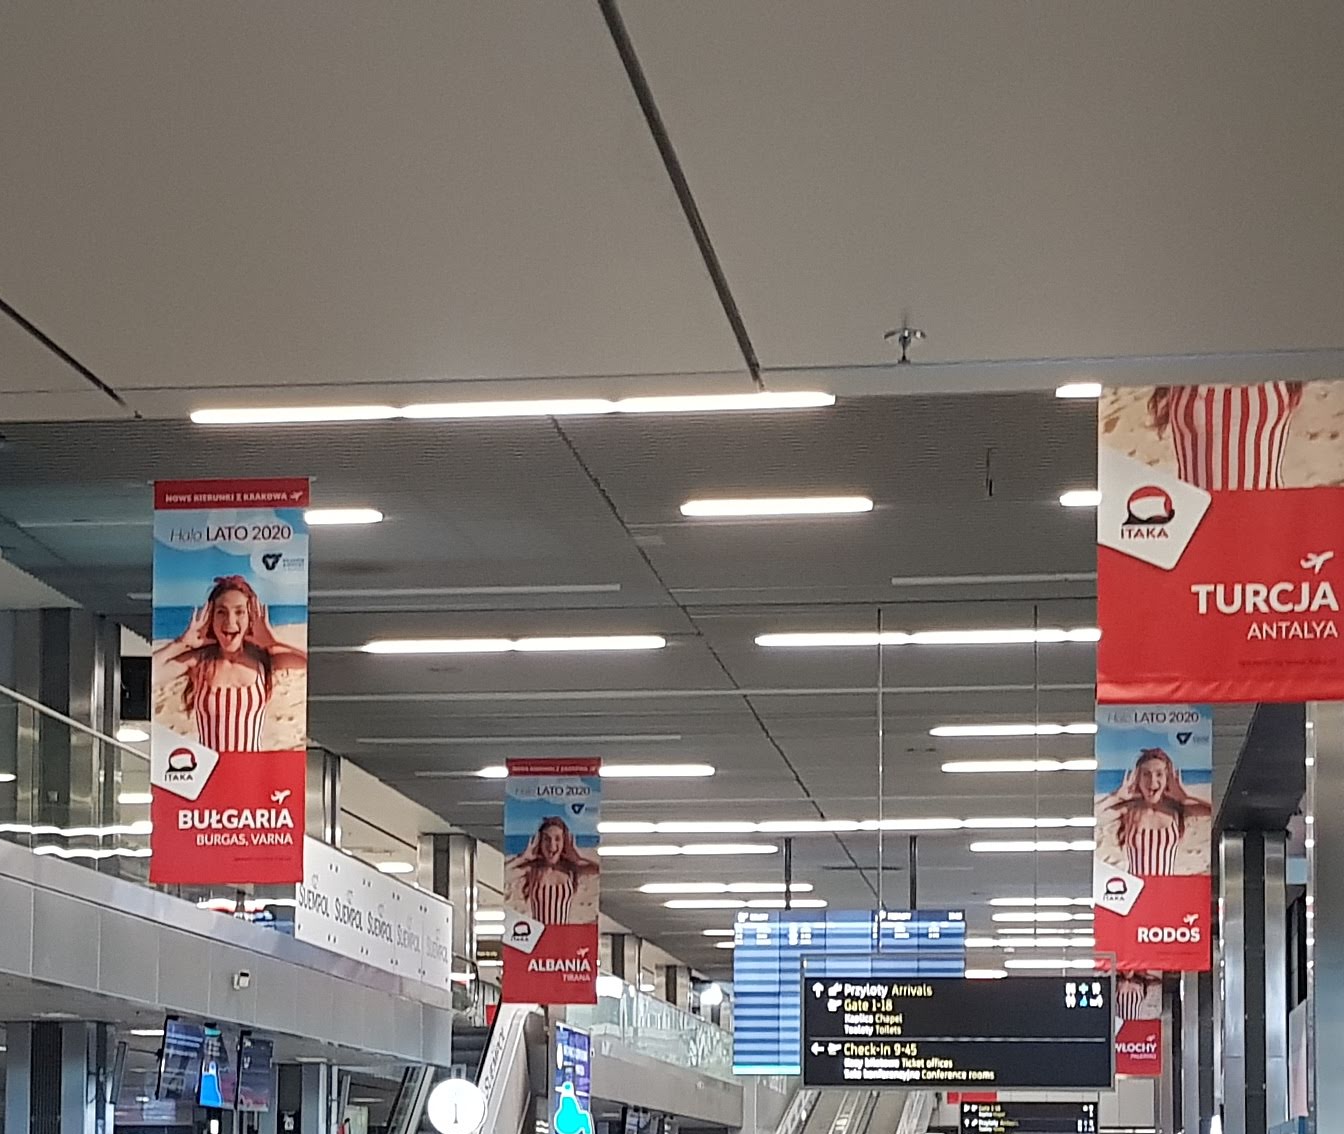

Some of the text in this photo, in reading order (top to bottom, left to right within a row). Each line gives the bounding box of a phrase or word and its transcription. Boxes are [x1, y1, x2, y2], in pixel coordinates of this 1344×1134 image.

[206, 525, 248, 541] LATO
[251, 524, 292, 541] 2020
[1120, 527, 1169, 540] ITAKA
[1190, 581, 1339, 615] TURCJA
[1247, 620, 1339, 641] ANTALYA
[1134, 712, 1167, 724] LATO
[1168, 711, 1199, 723] 2020
[164, 773, 193, 782] ITAKA
[537, 786, 564, 796] LATO
[565, 786, 591, 796] 2020
[177, 808, 294, 830] BUŁGARIA
[196, 832, 294, 846] BURGAS, VARNA
[1137, 926, 1201, 943] RODOS
[527, 958, 592, 972] ALBANIA
[844, 982, 933, 999] Przyloty Arrivals
[844, 998, 893, 1012] Gate 1-18
[875, 1012, 903, 1025] Chapel
[875, 1024, 902, 1036] Toilets
[844, 1042, 918, 1057] Check-in 9-45
[901, 1057, 925, 1069] Ticket
[926, 1057, 954, 1069] offices
[921, 1069, 967, 1080] Conference
[968, 1070, 995, 1080] rooms
